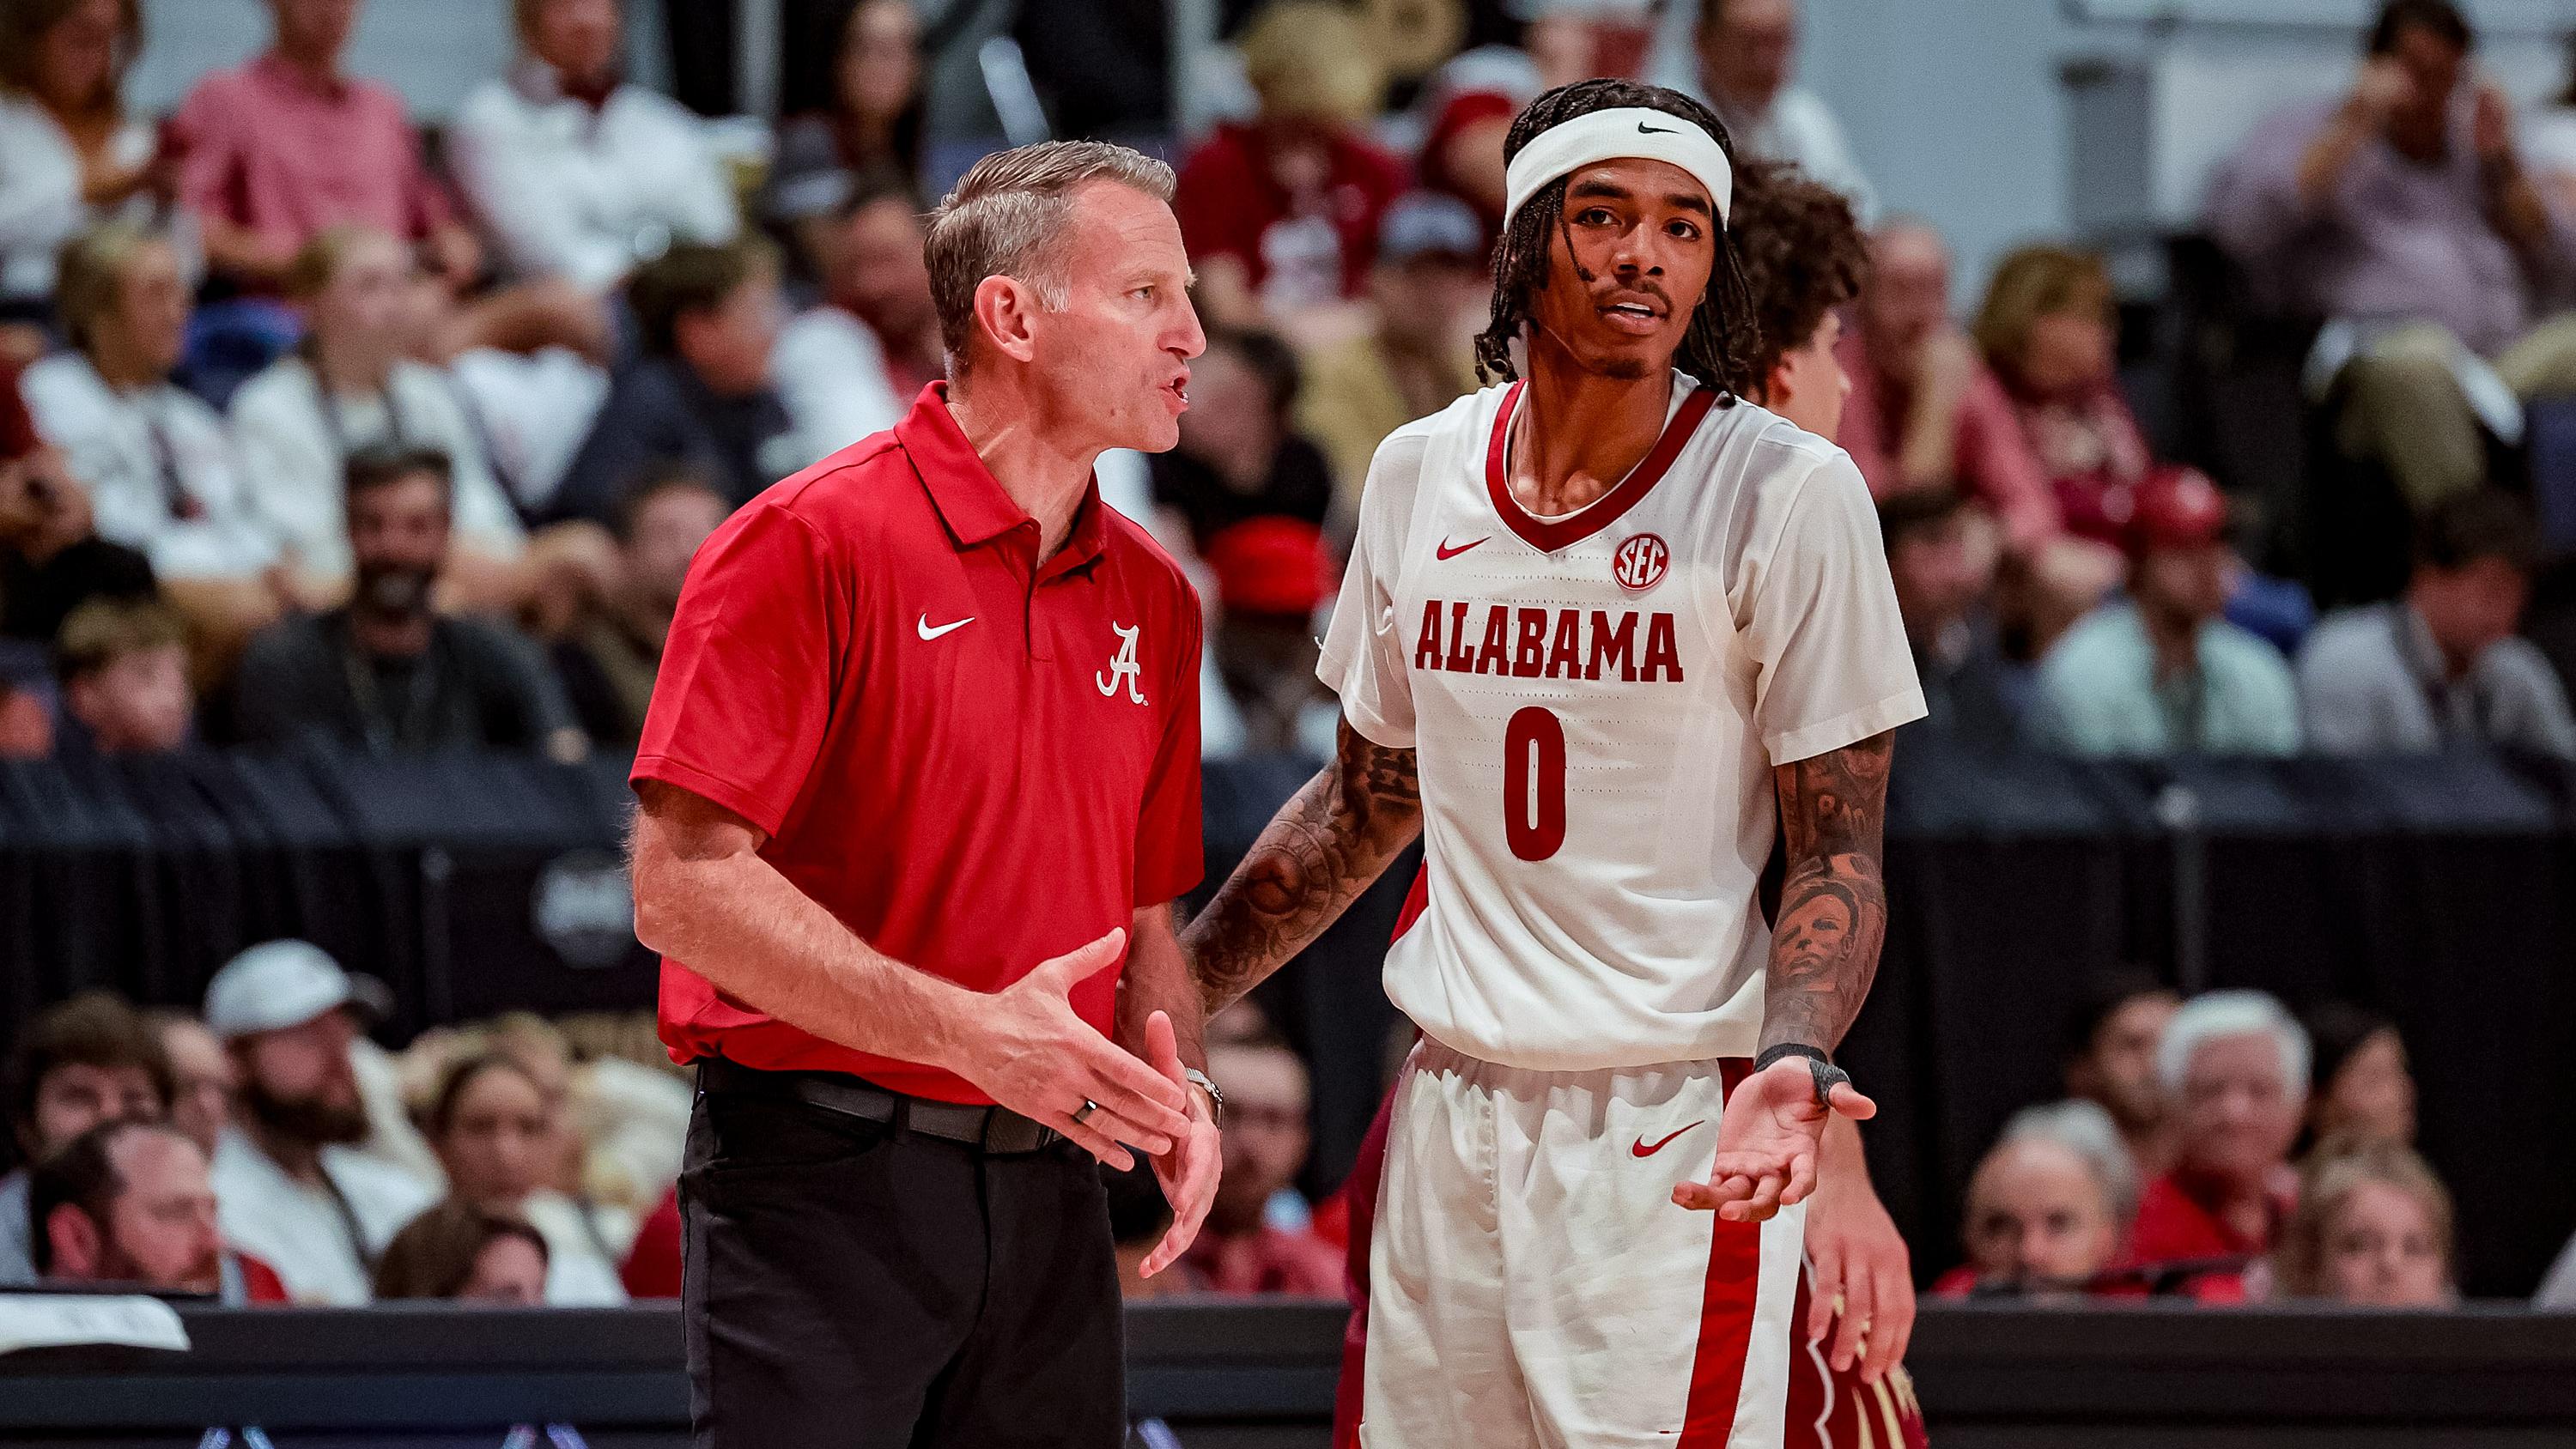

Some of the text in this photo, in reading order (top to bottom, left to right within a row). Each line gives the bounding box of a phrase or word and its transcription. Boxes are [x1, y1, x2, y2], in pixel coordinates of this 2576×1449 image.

[1617, 537, 1665, 585] SEC
[1096, 620, 1145, 704] A
[1414, 599, 1684, 683] ALABAMA
[1504, 706, 1566, 862] 0
